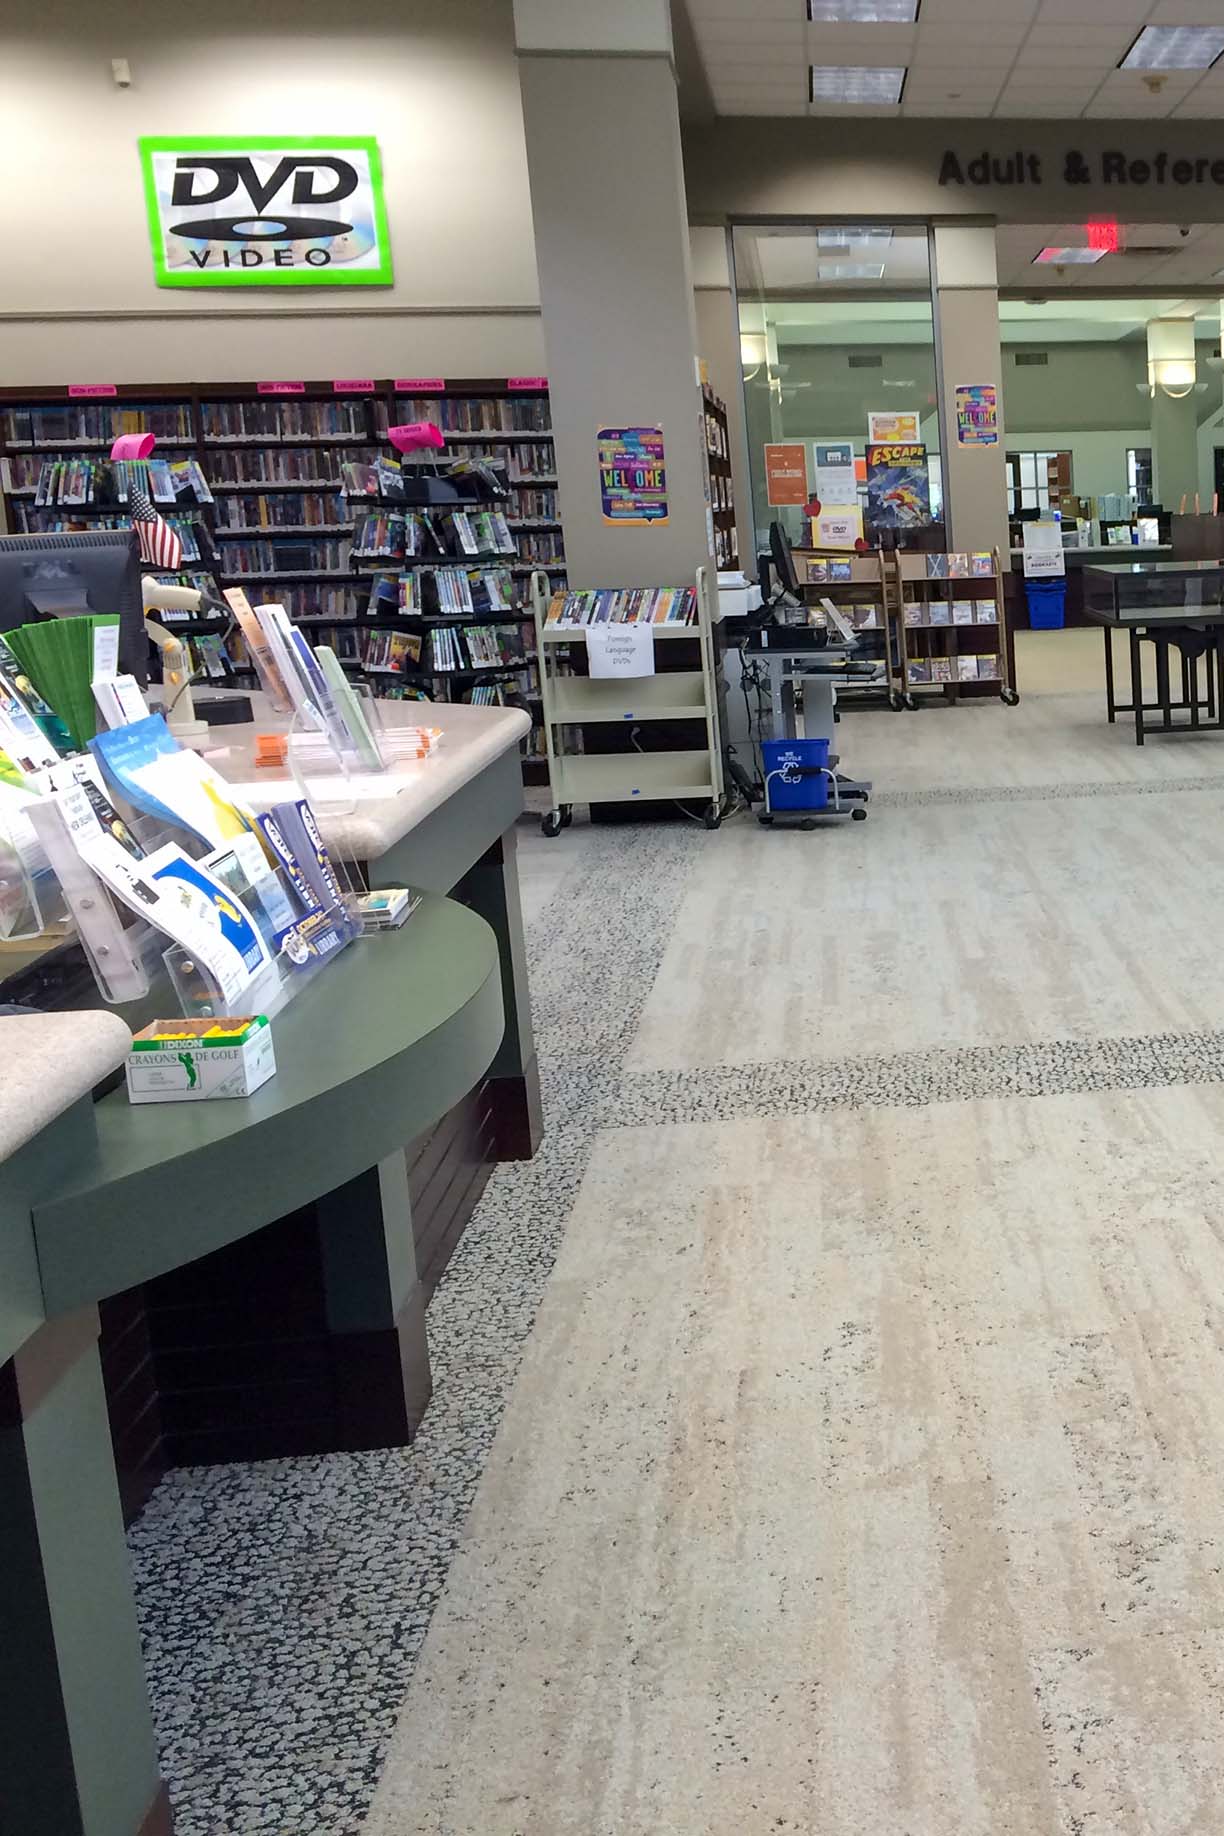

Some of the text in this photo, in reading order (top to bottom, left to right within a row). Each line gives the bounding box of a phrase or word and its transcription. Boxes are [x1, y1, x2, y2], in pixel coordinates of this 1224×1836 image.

[938, 151, 1041, 186] Adult
[1063, 151, 1092, 184] &
[171, 156, 359, 215] DVD
[189, 249, 331, 268] VIDEO
[871, 446, 924, 466] ESCAPE
[603, 469, 663, 488] WELOME
[314, 930, 341, 955] LIBRARY
[167, 1039, 203, 1050] DIXON
[128, 1049, 240, 1066] CRAYONS DE GOLF
